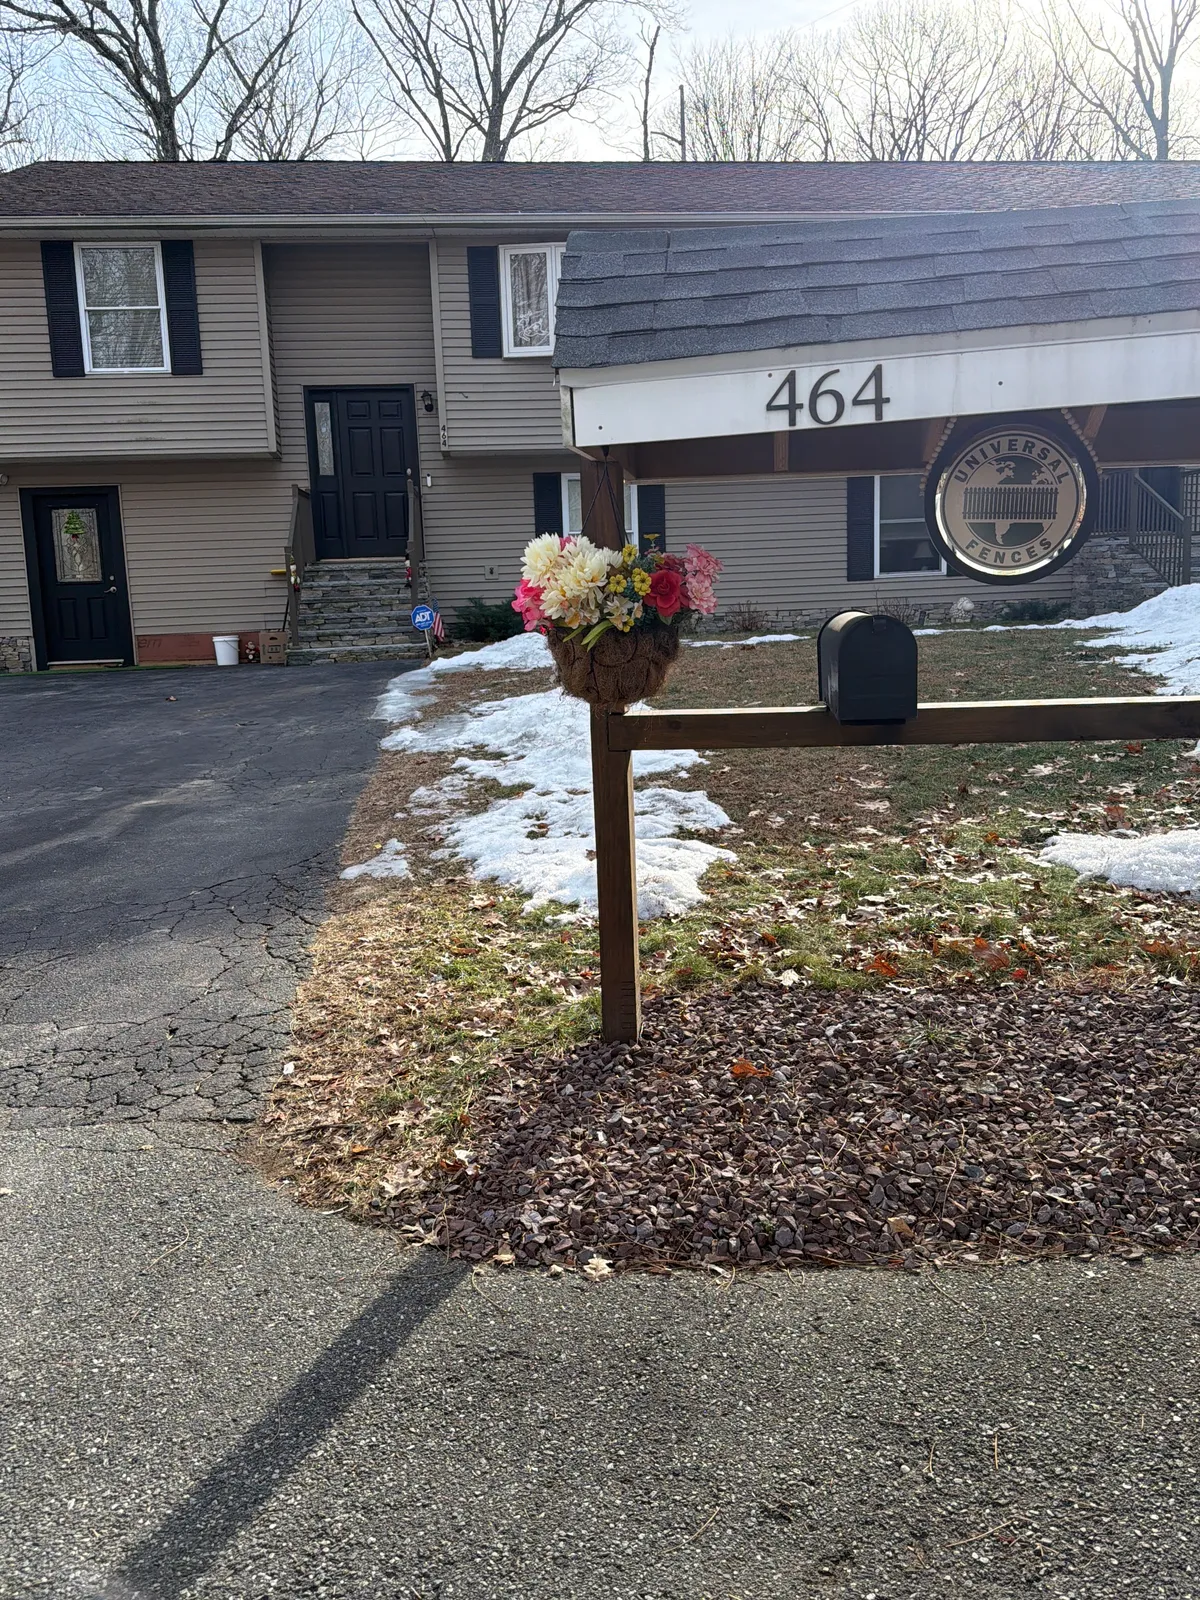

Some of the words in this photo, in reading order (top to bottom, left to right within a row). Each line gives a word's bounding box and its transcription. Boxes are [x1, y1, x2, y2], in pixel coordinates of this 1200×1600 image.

[766, 364, 891, 427] 464
[953, 438, 1070, 484] UNIVERSAL
[965, 537, 1052, 564] FENCES
[415, 611, 431, 623] ADT
